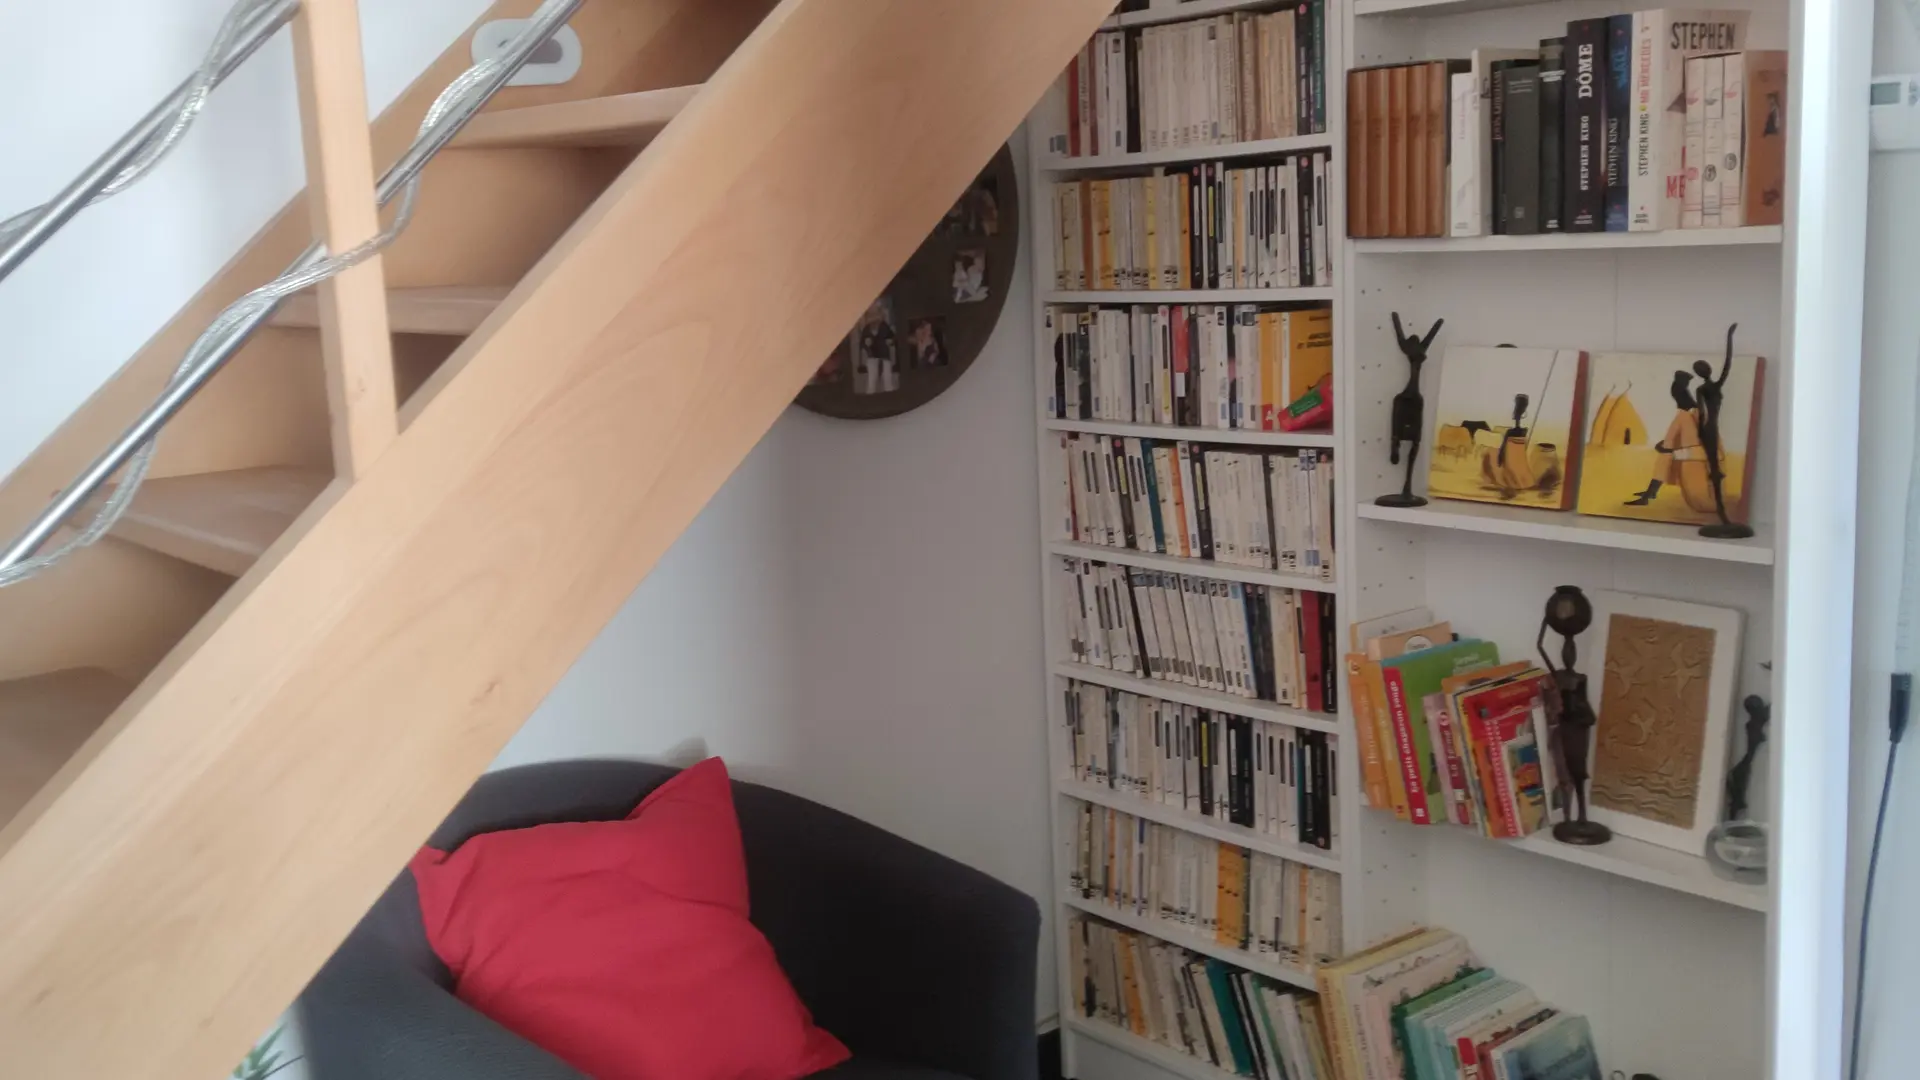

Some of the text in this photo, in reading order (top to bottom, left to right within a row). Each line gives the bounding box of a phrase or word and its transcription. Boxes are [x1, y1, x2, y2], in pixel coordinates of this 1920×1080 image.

[1671, 22, 1736, 50] STEPHEN
[1580, 115, 1589, 141] KING
[1639, 113, 1649, 136] KING
[1608, 118, 1618, 187] STEPHEN KING
[1638, 137, 1649, 176] STEPHEN
[1580, 144, 1589, 190] STEPHEN
[1390, 680, 1402, 708] rouge
[1403, 756, 1418, 781] petit
